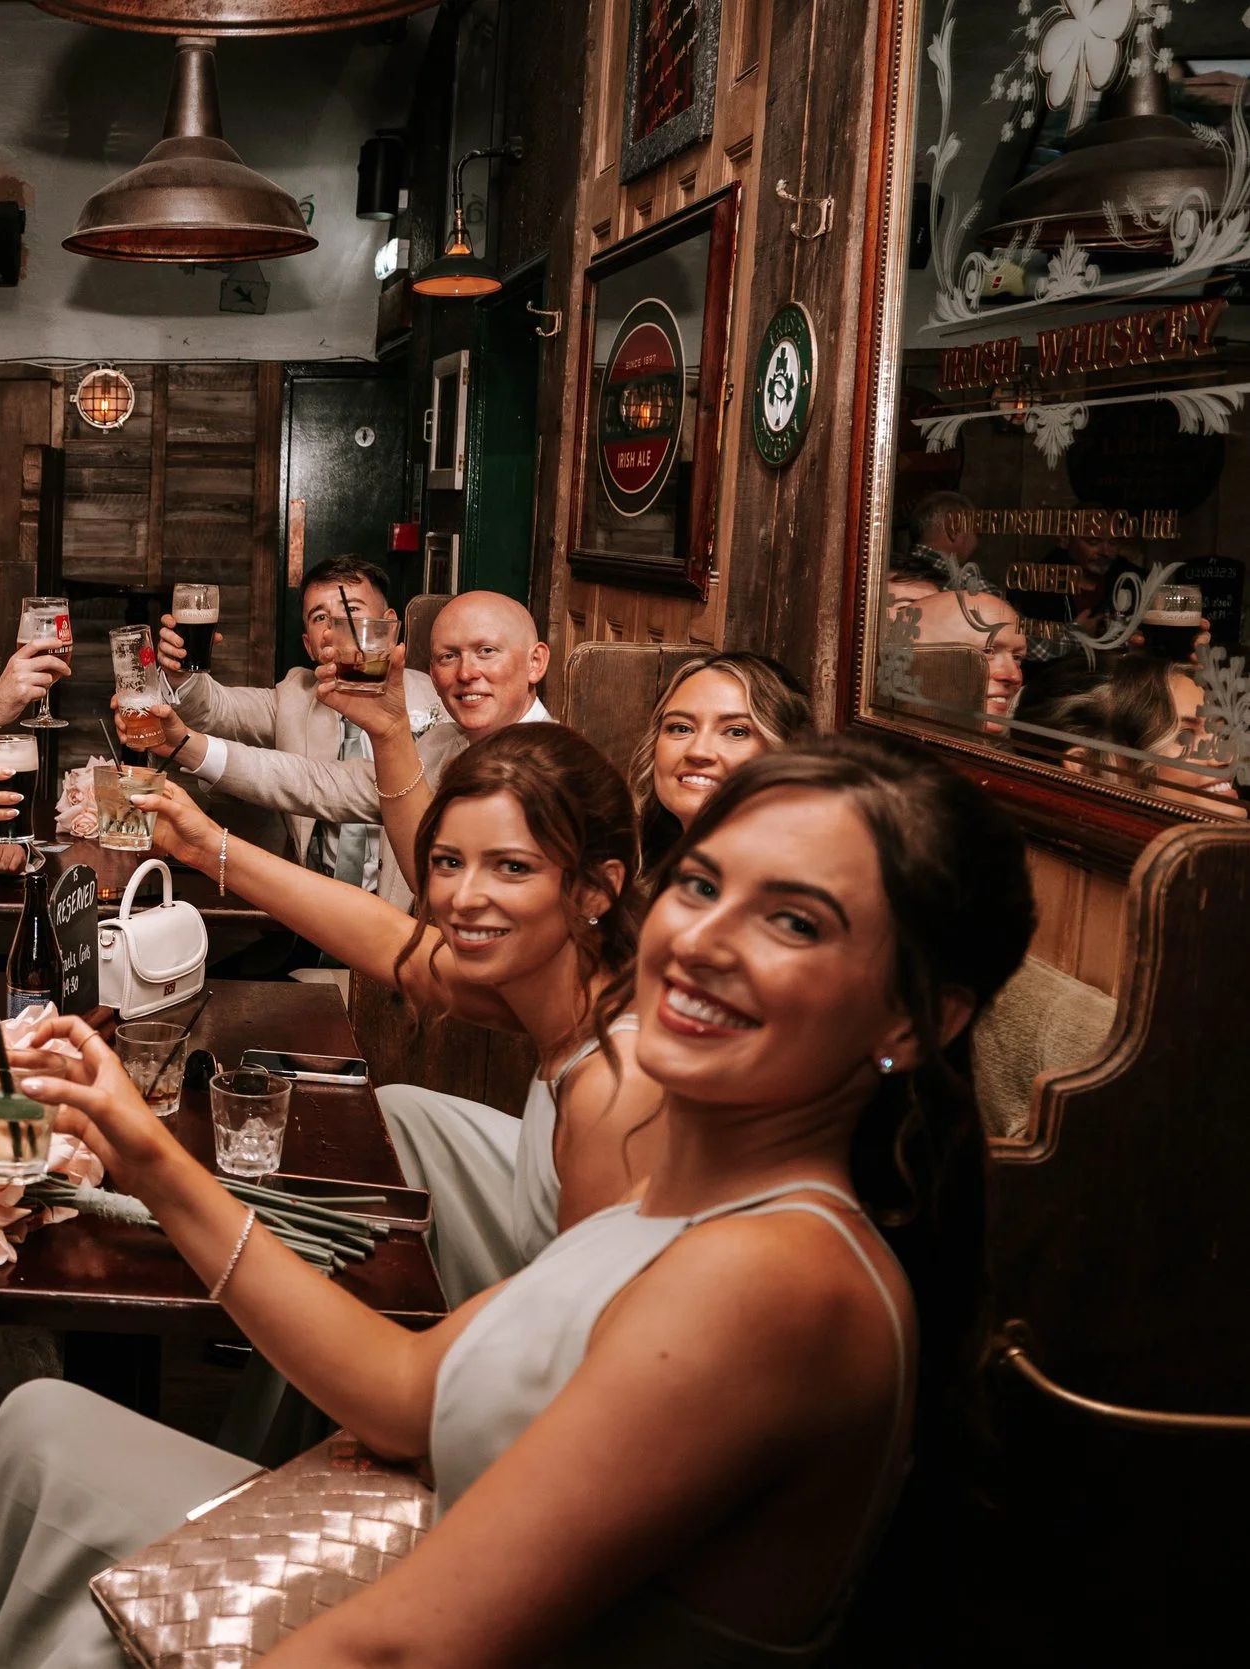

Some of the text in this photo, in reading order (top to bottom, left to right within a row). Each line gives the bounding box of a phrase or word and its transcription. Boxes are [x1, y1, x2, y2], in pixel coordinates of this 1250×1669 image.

[938, 296, 1231, 393] IRISH WHISKEY
[625, 357, 642, 370] SINCE
[617, 449, 652, 469] IRISH ALE
[943, 508, 1003, 542] COMBER
[1003, 508, 1107, 538] DISTILLERIES
[1108, 508, 1139, 538] Co
[1006, 562, 1083, 596] COMBER
[56, 880, 96, 927] RESERVED
